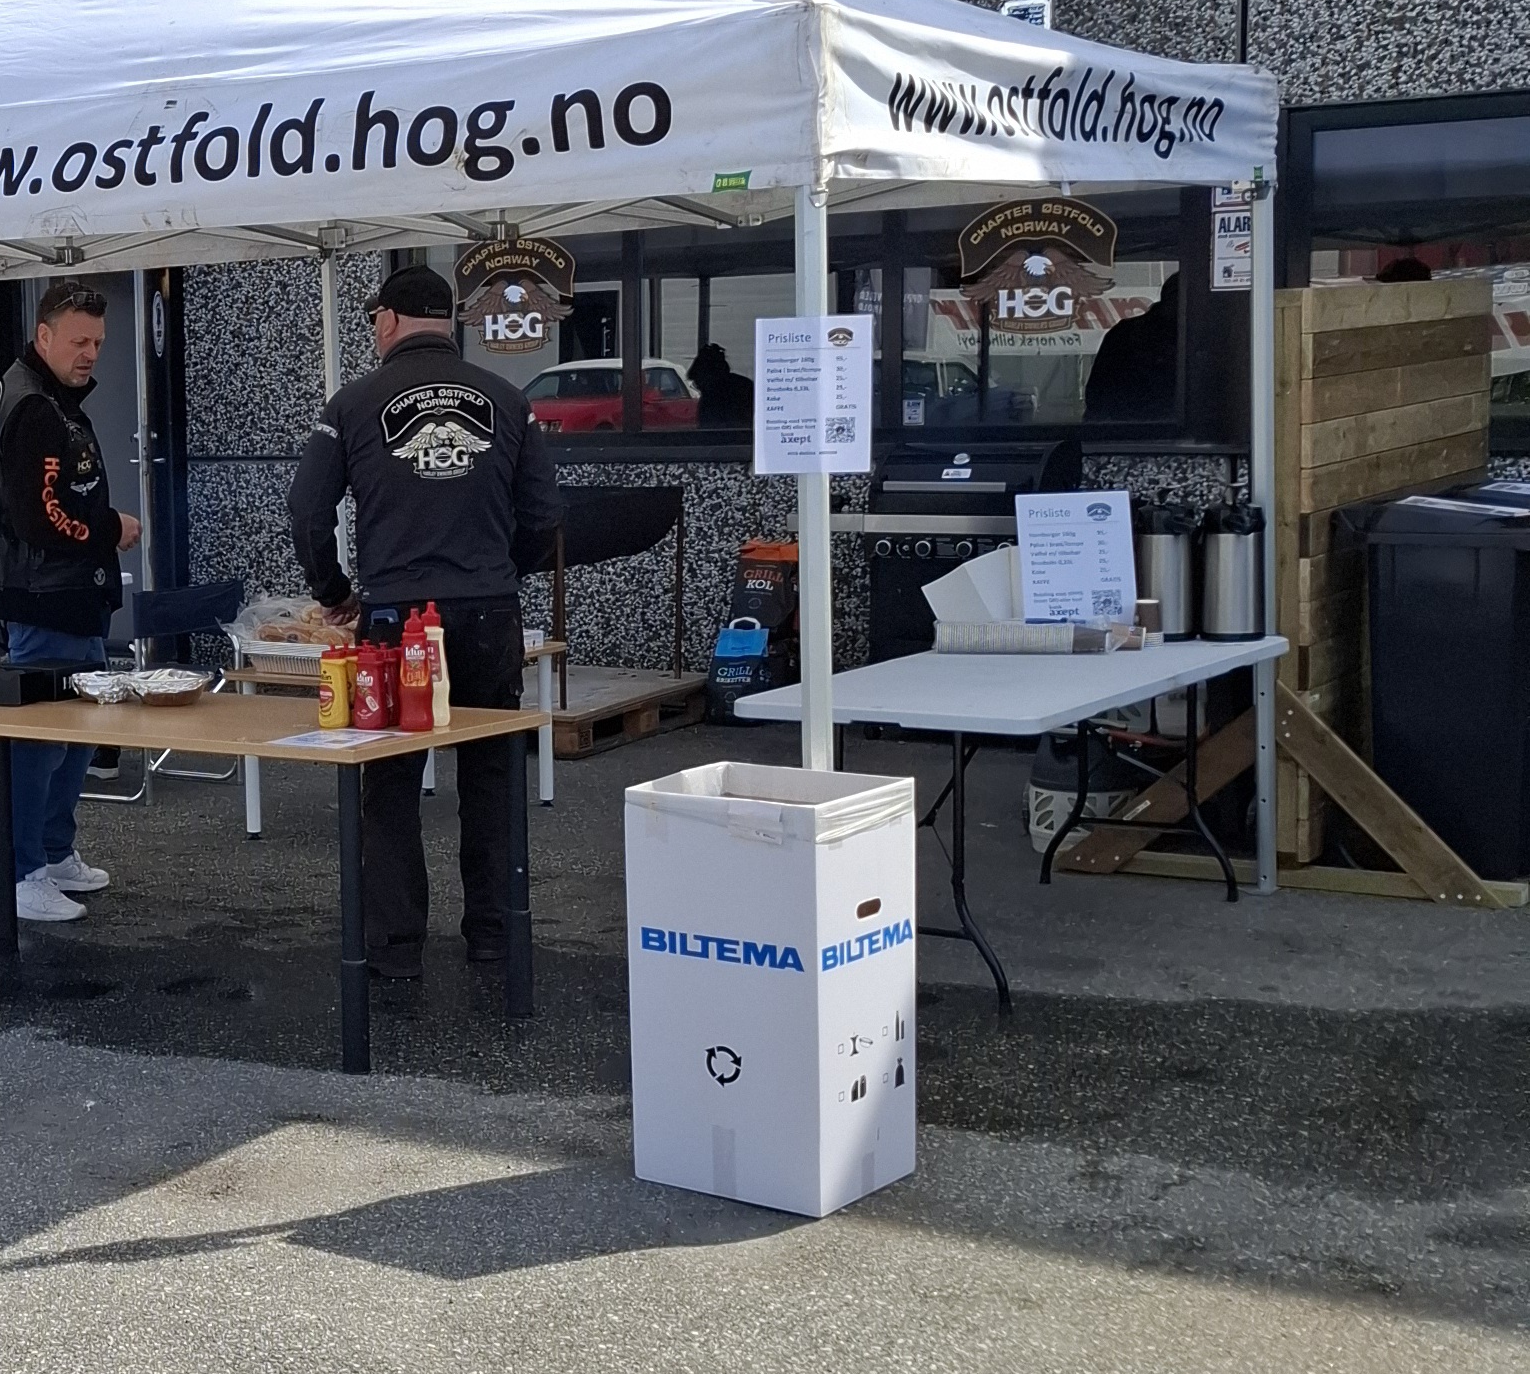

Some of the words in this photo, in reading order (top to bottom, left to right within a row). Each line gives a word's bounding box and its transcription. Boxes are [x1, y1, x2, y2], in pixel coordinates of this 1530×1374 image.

[888, 66, 1225, 159] www.ostfold.hog.no
[970, 204, 1032, 245] CHAPTER
[1041, 203, 1105, 237] ØSTFOLD
[1000, 220, 1071, 238] NORWAY
[1218, 216, 1251, 233] ALAR
[485, 255, 540, 271] NORWAY
[997, 286, 1074, 318] HOG
[484, 312, 544, 341] HOG
[768, 333, 812, 344] Prisliste
[391, 390, 434, 414] CHAPTER
[438, 388, 484, 406] ØSTFOLD
[416, 398, 461, 411] NORWAY
[781, 435, 812, 445] axept
[417, 446, 470, 470] HOG
[1028, 507, 1071, 518] Prisliste
[743, 569, 783, 583] GRILL
[745, 579, 774, 591] KOL
[1049, 607, 1080, 617] axept
[405, 646, 426, 657] Idun
[717, 666, 752, 677] GRILL
[640, 926, 806, 973] BILTEMA
[821, 917, 914, 972] BILTEMA
